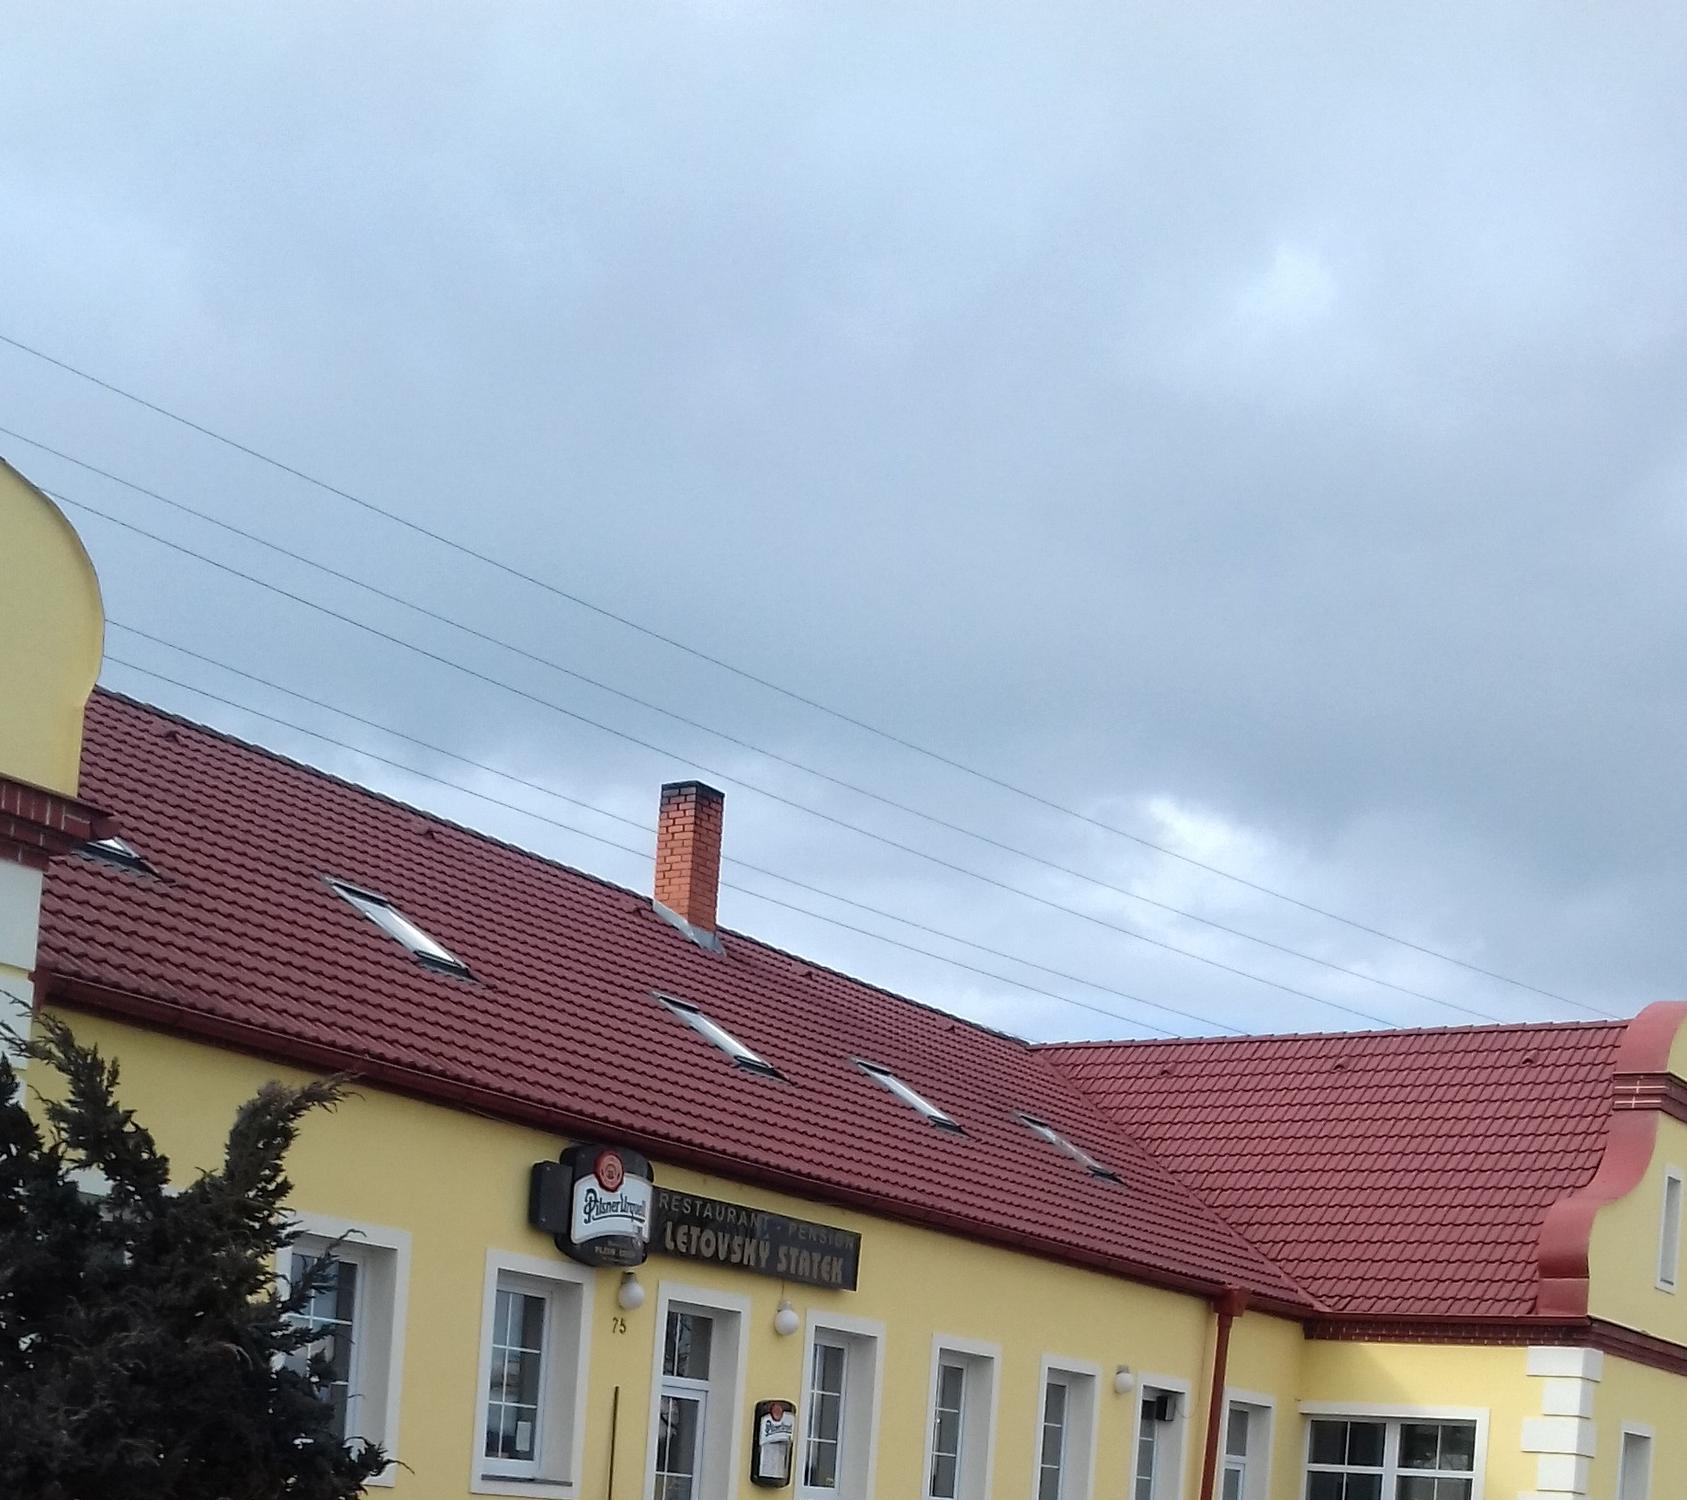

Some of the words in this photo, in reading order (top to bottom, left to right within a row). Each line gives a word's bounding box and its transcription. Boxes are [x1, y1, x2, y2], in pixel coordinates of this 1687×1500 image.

[583, 1188, 620, 1225] Pilsner
[659, 1193, 769, 1231] RESTAURANT
[788, 1221, 855, 1249] PENSION
[776, 1245, 844, 1284] STATEK
[612, 1316, 627, 1335] 75
